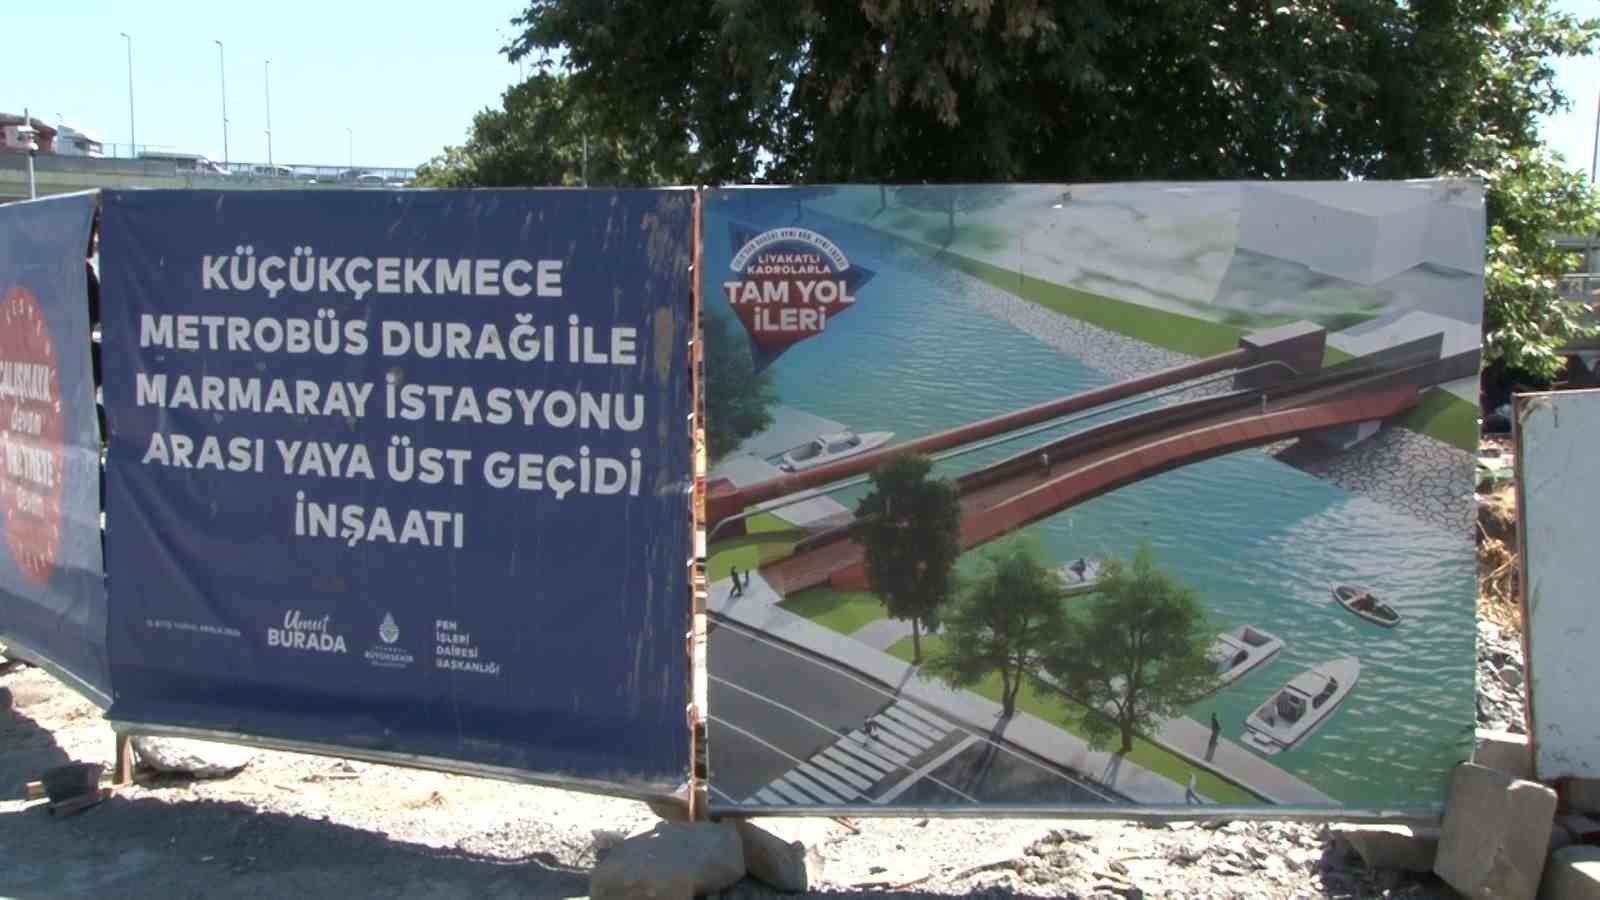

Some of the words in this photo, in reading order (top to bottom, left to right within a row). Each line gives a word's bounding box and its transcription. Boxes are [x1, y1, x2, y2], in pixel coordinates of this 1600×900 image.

[203, 246, 563, 300] KÜÇÜKÇEKMECE
[724, 281, 789, 303] TAM
[795, 281, 857, 303] YOL
[747, 265, 832, 274] KADROLARLA
[140, 308, 369, 355] METROBÜS
[382, 313, 554, 362] DURAĞI
[568, 314, 637, 364] İLE
[754, 307, 827, 331] İLERİ
[136, 373, 373, 417] MARMARAY
[386, 372, 645, 431] İSTASYONU
[142, 432, 264, 472] ARASI
[276, 440, 375, 480] YAYA
[387, 436, 472, 485] ÜST
[484, 445, 642, 499] GEÇİDİ
[295, 491, 464, 547] İNŞAATI
[267, 628, 347, 653] BURADA
